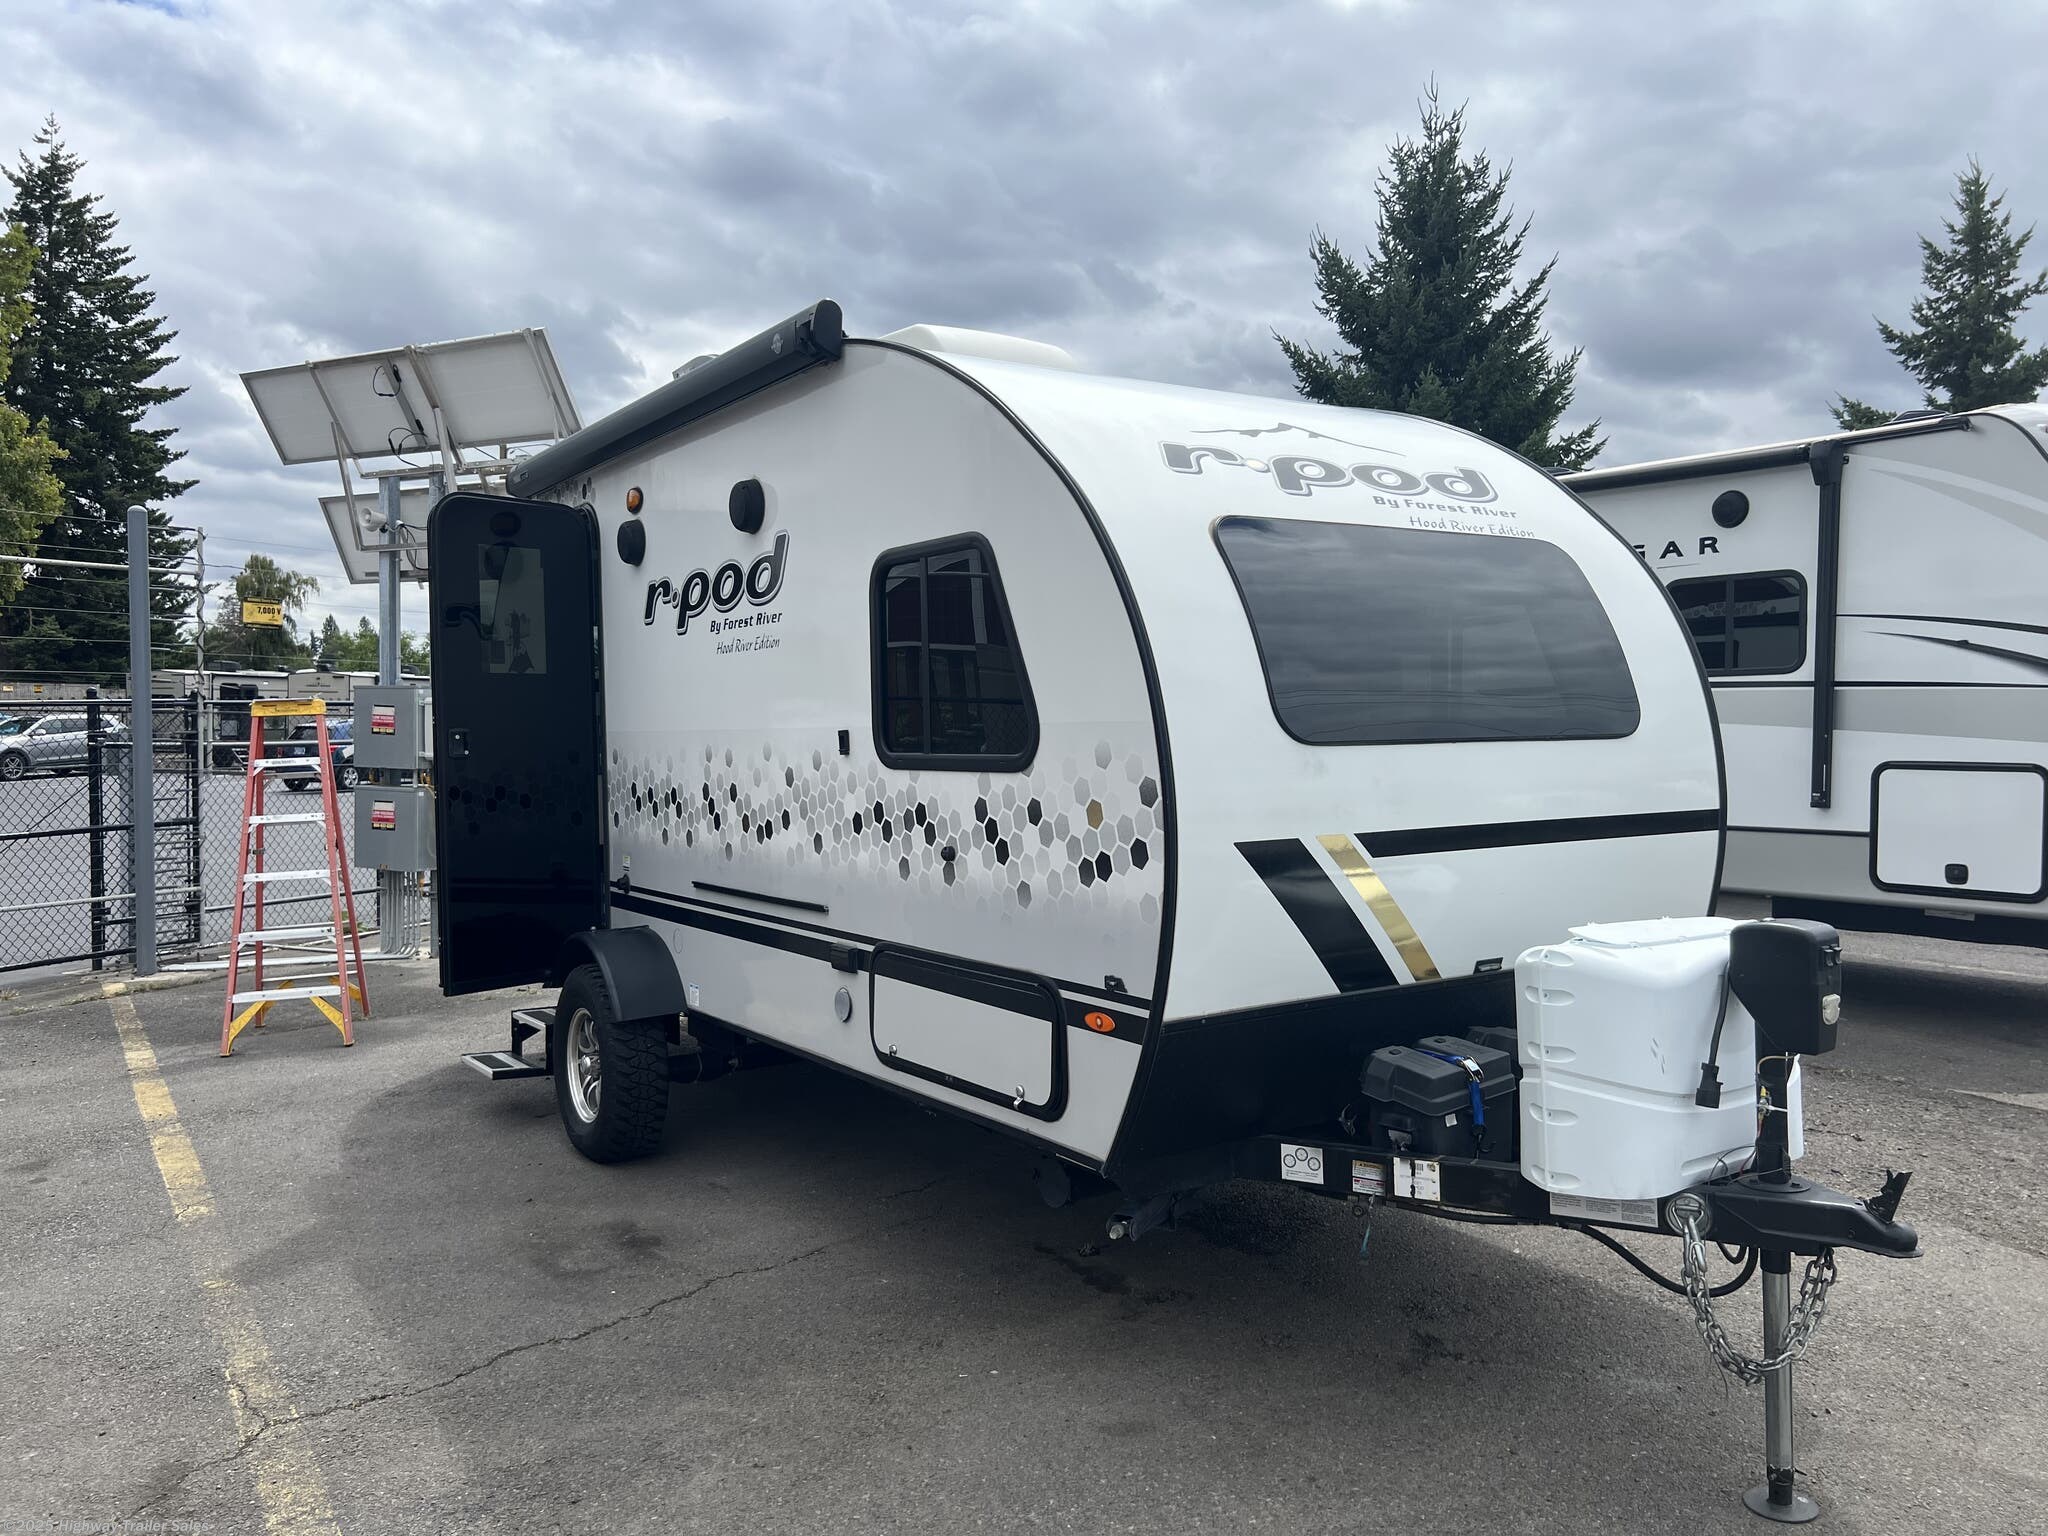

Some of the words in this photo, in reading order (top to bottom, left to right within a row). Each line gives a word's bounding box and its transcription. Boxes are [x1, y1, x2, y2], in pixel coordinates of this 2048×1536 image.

[1372, 495, 1400, 509] By
[1404, 498, 1467, 514] Forest
[1471, 506, 1517, 519] River
[1409, 515, 1447, 530] Hood
[1450, 519, 1485, 534] River
[1488, 524, 1535, 538] Edition
[257, 606, 276, 615] 7,000
[710, 620, 721, 635] By
[723, 615, 754, 631] Forest
[756, 612, 782, 626] River
[716, 637, 736, 655] Hood
[735, 638, 753, 652] River
[754, 633, 780, 651] Edition
